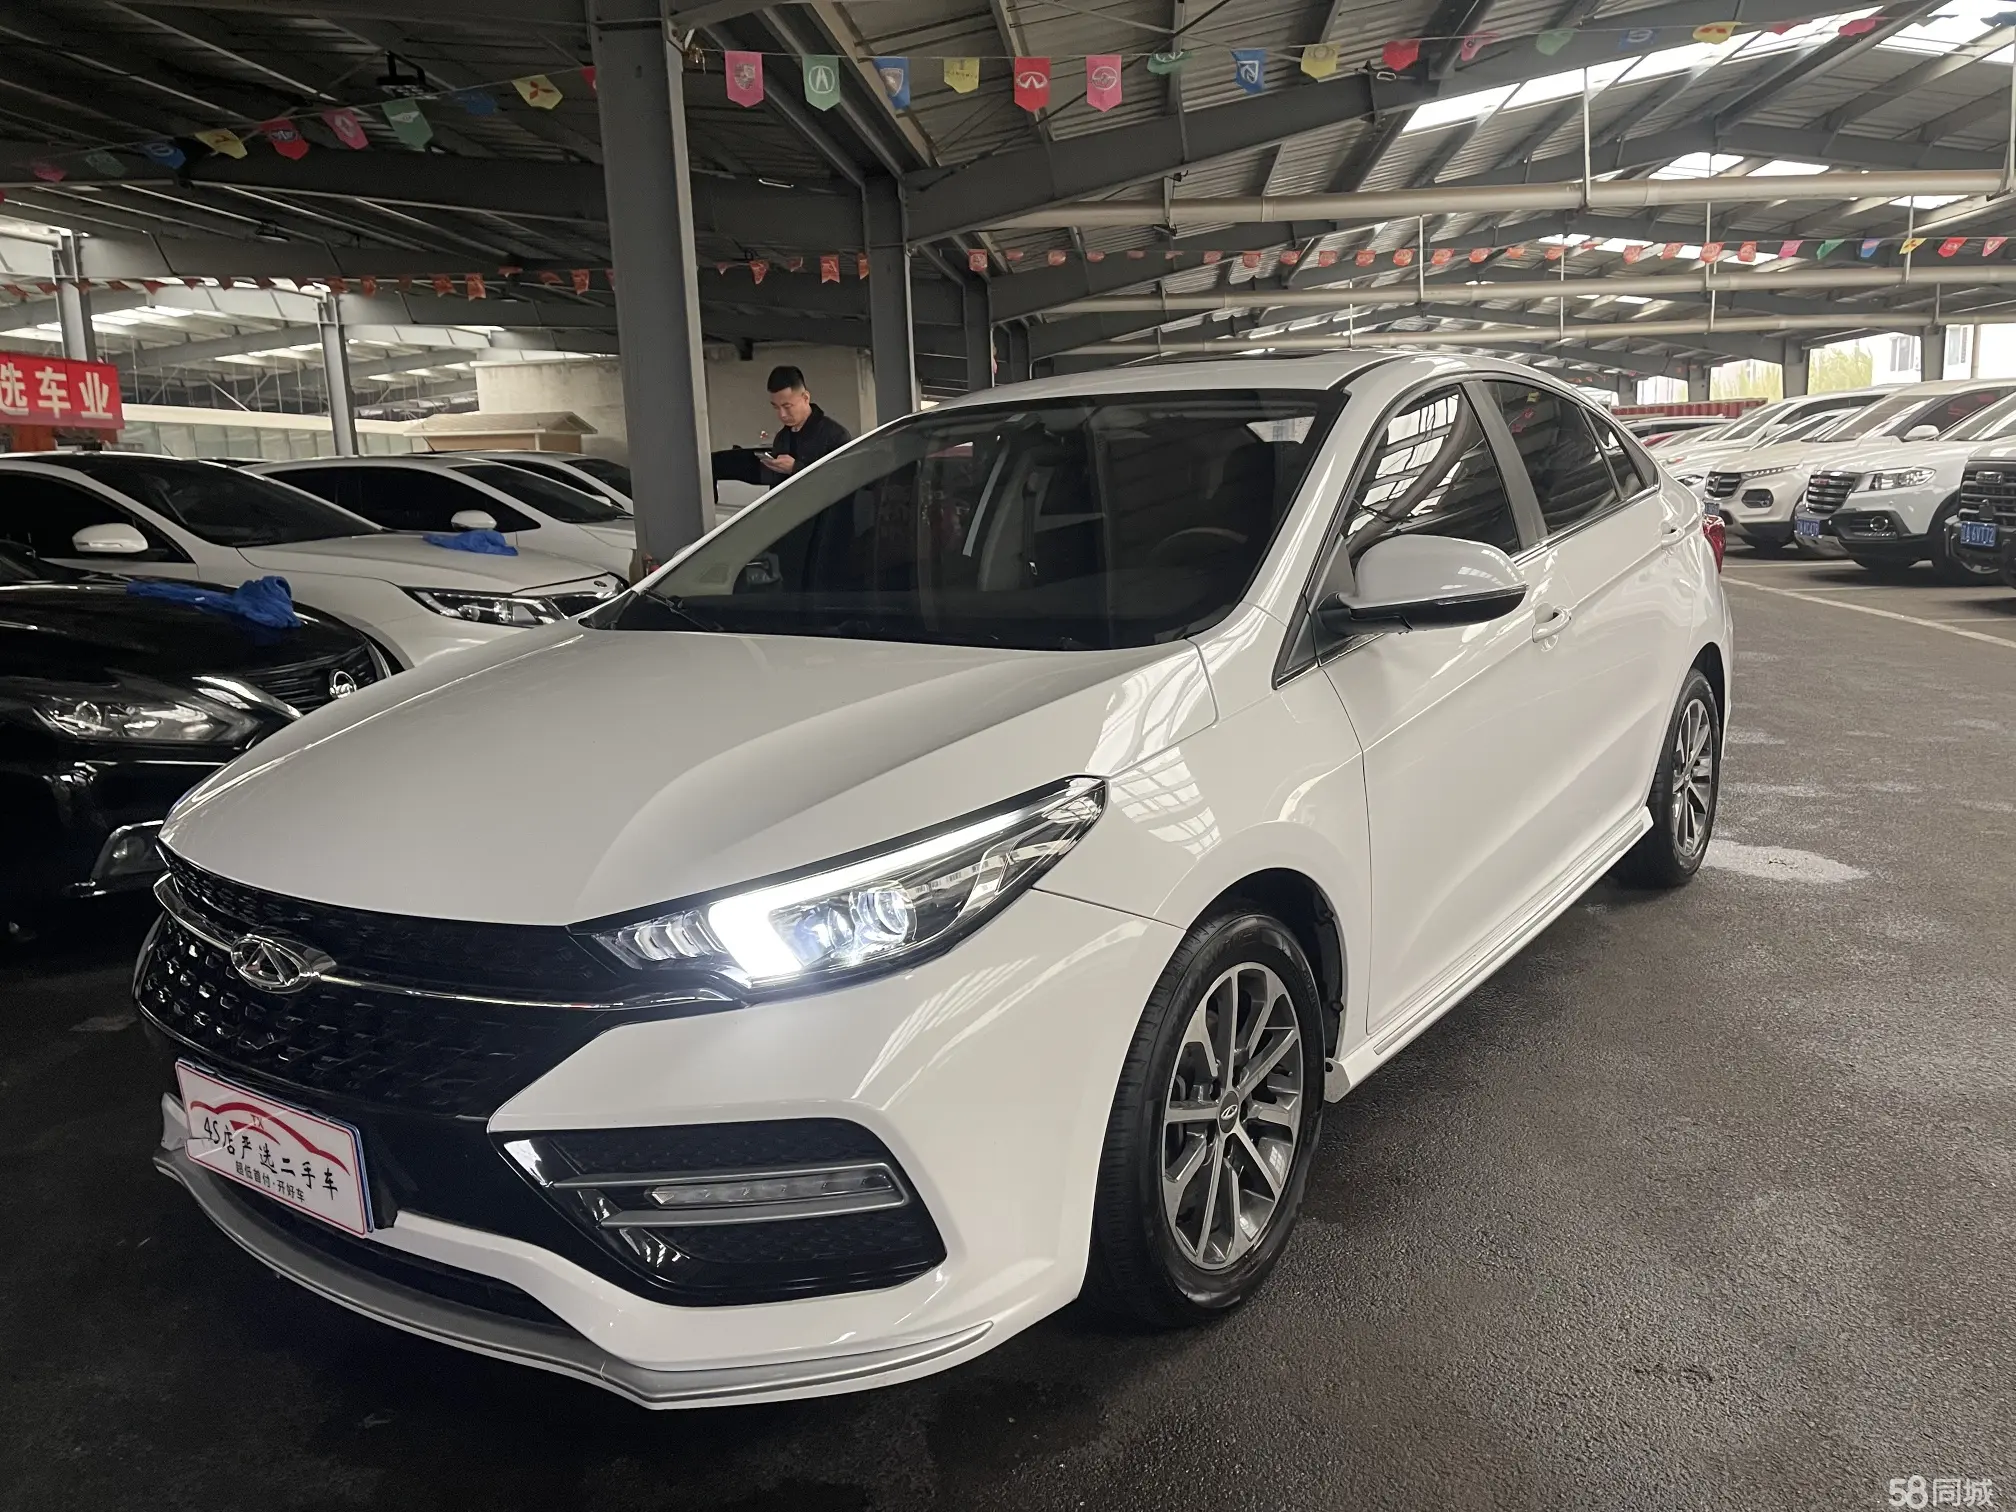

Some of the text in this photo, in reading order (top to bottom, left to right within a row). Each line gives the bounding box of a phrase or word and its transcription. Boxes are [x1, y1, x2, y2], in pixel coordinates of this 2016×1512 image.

[0, 362, 113, 419] 选车业
[204, 1117, 338, 1200] 4S店严选二手车
